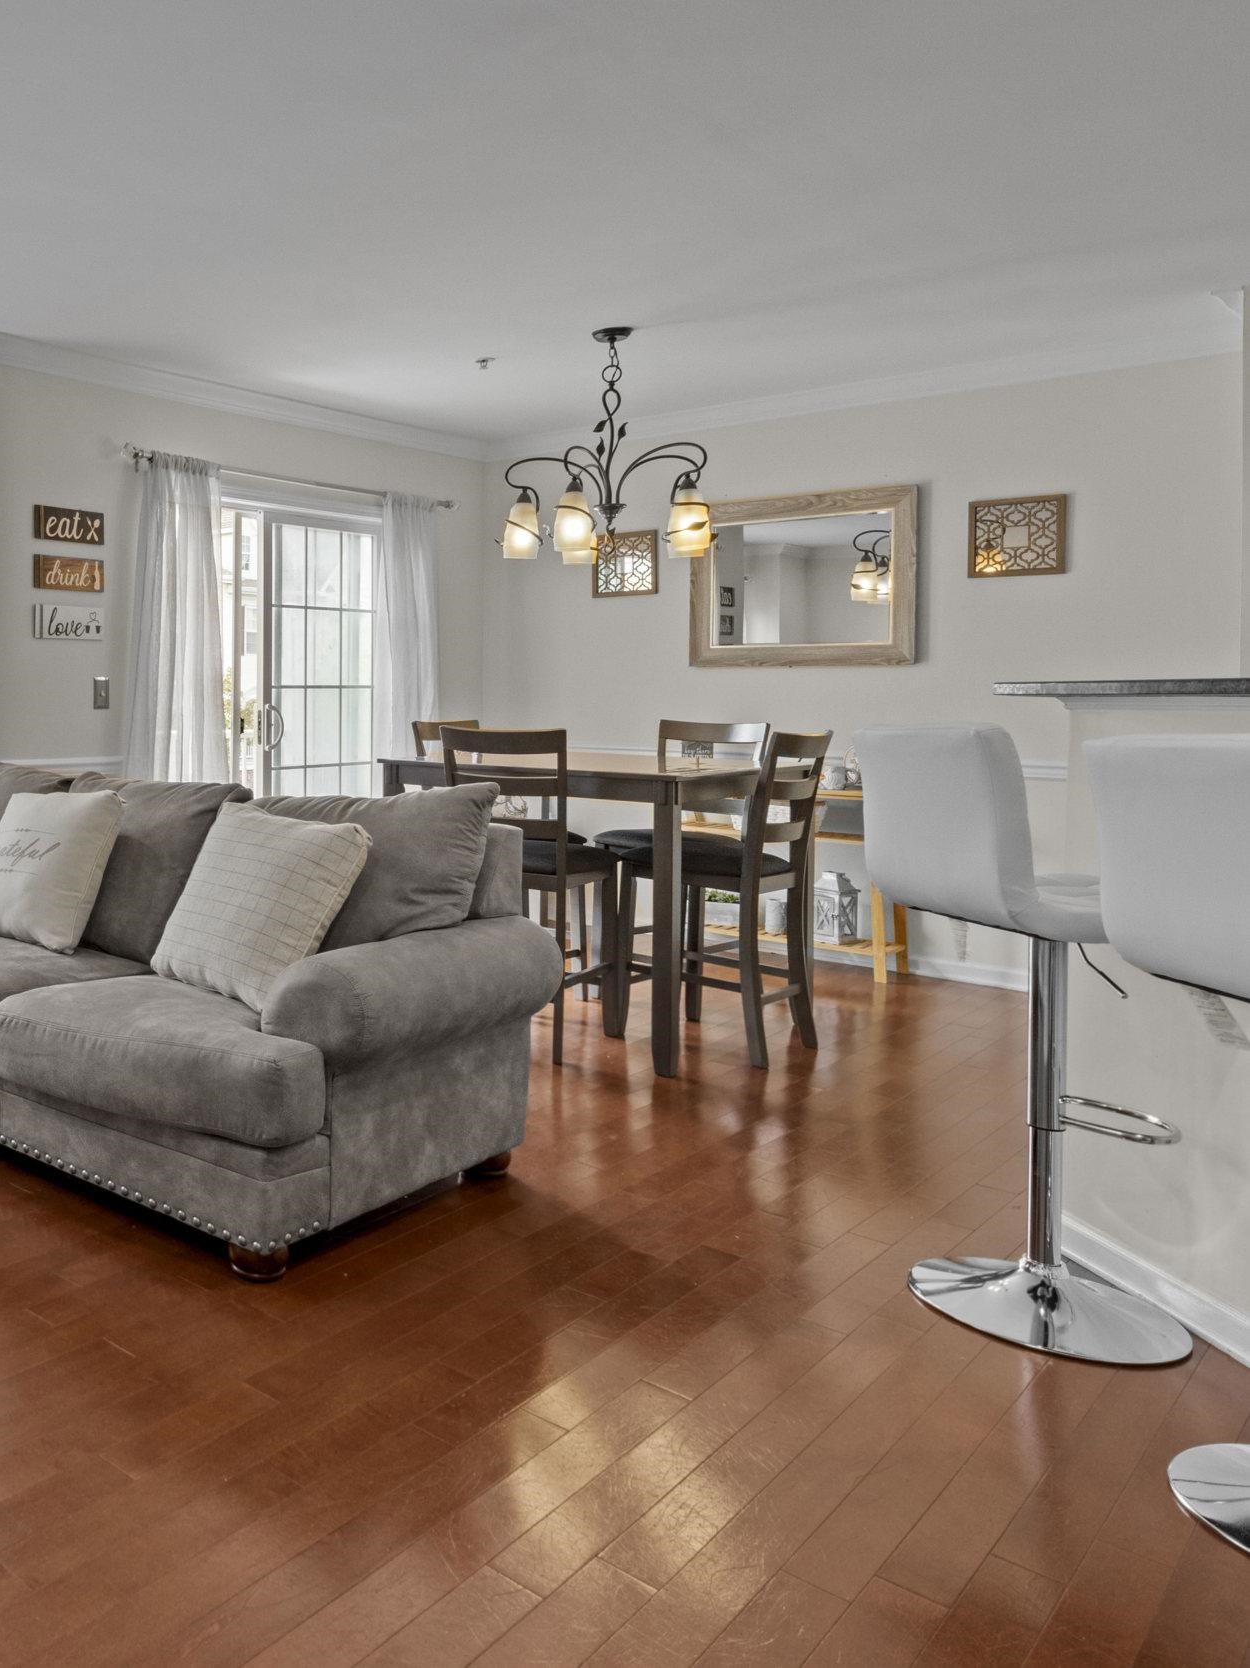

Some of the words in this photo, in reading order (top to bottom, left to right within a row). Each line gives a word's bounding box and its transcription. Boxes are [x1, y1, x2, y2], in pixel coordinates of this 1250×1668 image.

[46, 512, 84, 540] eat
[46, 559, 91, 587] drink
[48, 607, 86, 637] love
